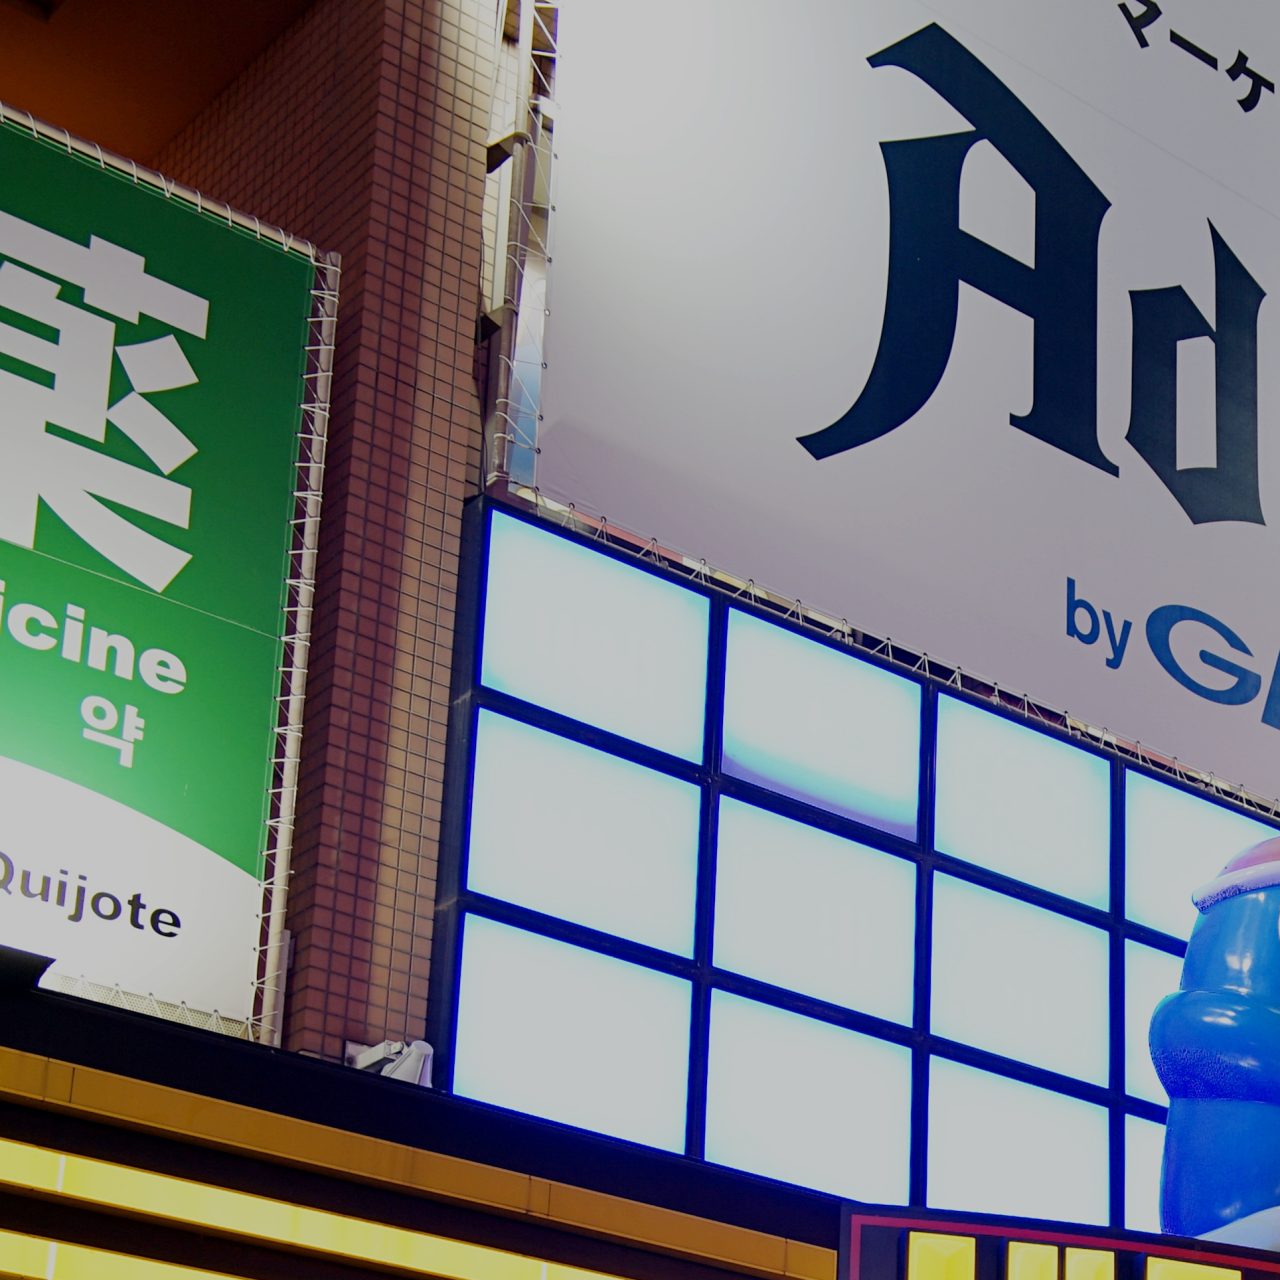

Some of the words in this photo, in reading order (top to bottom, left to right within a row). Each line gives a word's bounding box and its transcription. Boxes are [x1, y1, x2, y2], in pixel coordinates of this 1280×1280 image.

[0, 579, 187, 694] cine
[1066, 576, 1132, 669] by
[80, 695, 145, 768] 약
